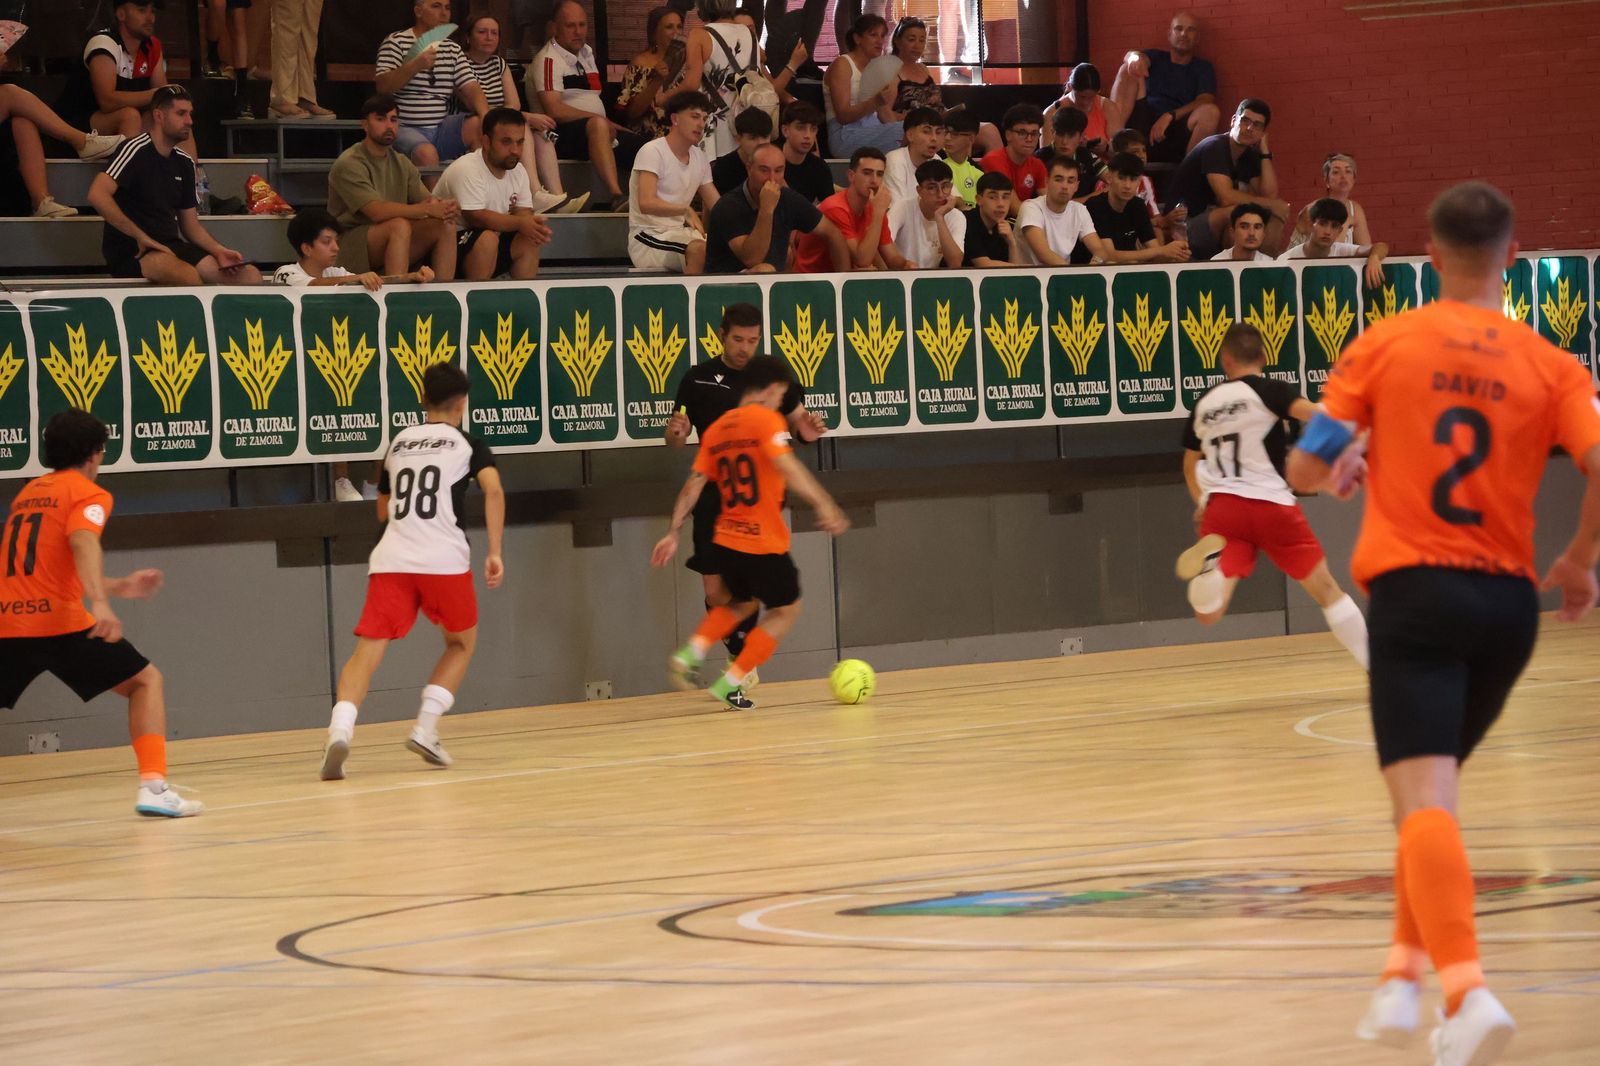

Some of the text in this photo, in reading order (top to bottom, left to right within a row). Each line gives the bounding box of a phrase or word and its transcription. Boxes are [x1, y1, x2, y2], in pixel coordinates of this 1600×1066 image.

[1054, 381, 1109, 396] CAJA RURAL
[1119, 378, 1173, 393] CAJA RURAL
[1183, 376, 1206, 390] CAJA
[1432, 371, 1507, 401] DAVID
[849, 390, 908, 407] CAJA RURAL
[919, 387, 976, 403] CAJA RURAL
[987, 384, 1044, 400] CAJA RURAL
[1129, 393, 1165, 404] DE ZAMORA
[803, 393, 838, 408] RURAL
[997, 400, 1034, 410] DE ZAMORA
[1064, 397, 1100, 407] DE ZAMORA
[472, 407, 540, 424] CAJA RURAL
[552, 403, 616, 420] CAJA RURAL
[627, 400, 676, 417] CAJA RUR
[860, 407, 898, 417] DE ZAMORA
[929, 403, 967, 414] DE ZAMORA
[224, 417, 296, 434] CAJA RURAL
[310, 413, 380, 430] CAJA RURAL
[392, 411, 420, 428] CAJA
[564, 421, 606, 432] DE ZAMORA
[639, 417, 672, 428] DE ZAMO
[135, 422, 165, 438] CAJA
[168, 420, 209, 436] RURAL
[484, 424, 528, 435] DE ZAMORA
[236, 435, 283, 446] DE ZAMORA
[322, 432, 367, 442] DE ZAMORA
[147, 439, 196, 451] DE ZAMORA
[1211, 432, 1242, 478] 17
[1430, 406, 1492, 526] 2
[395, 465, 441, 520] 98
[7, 512, 43, 576] 11
